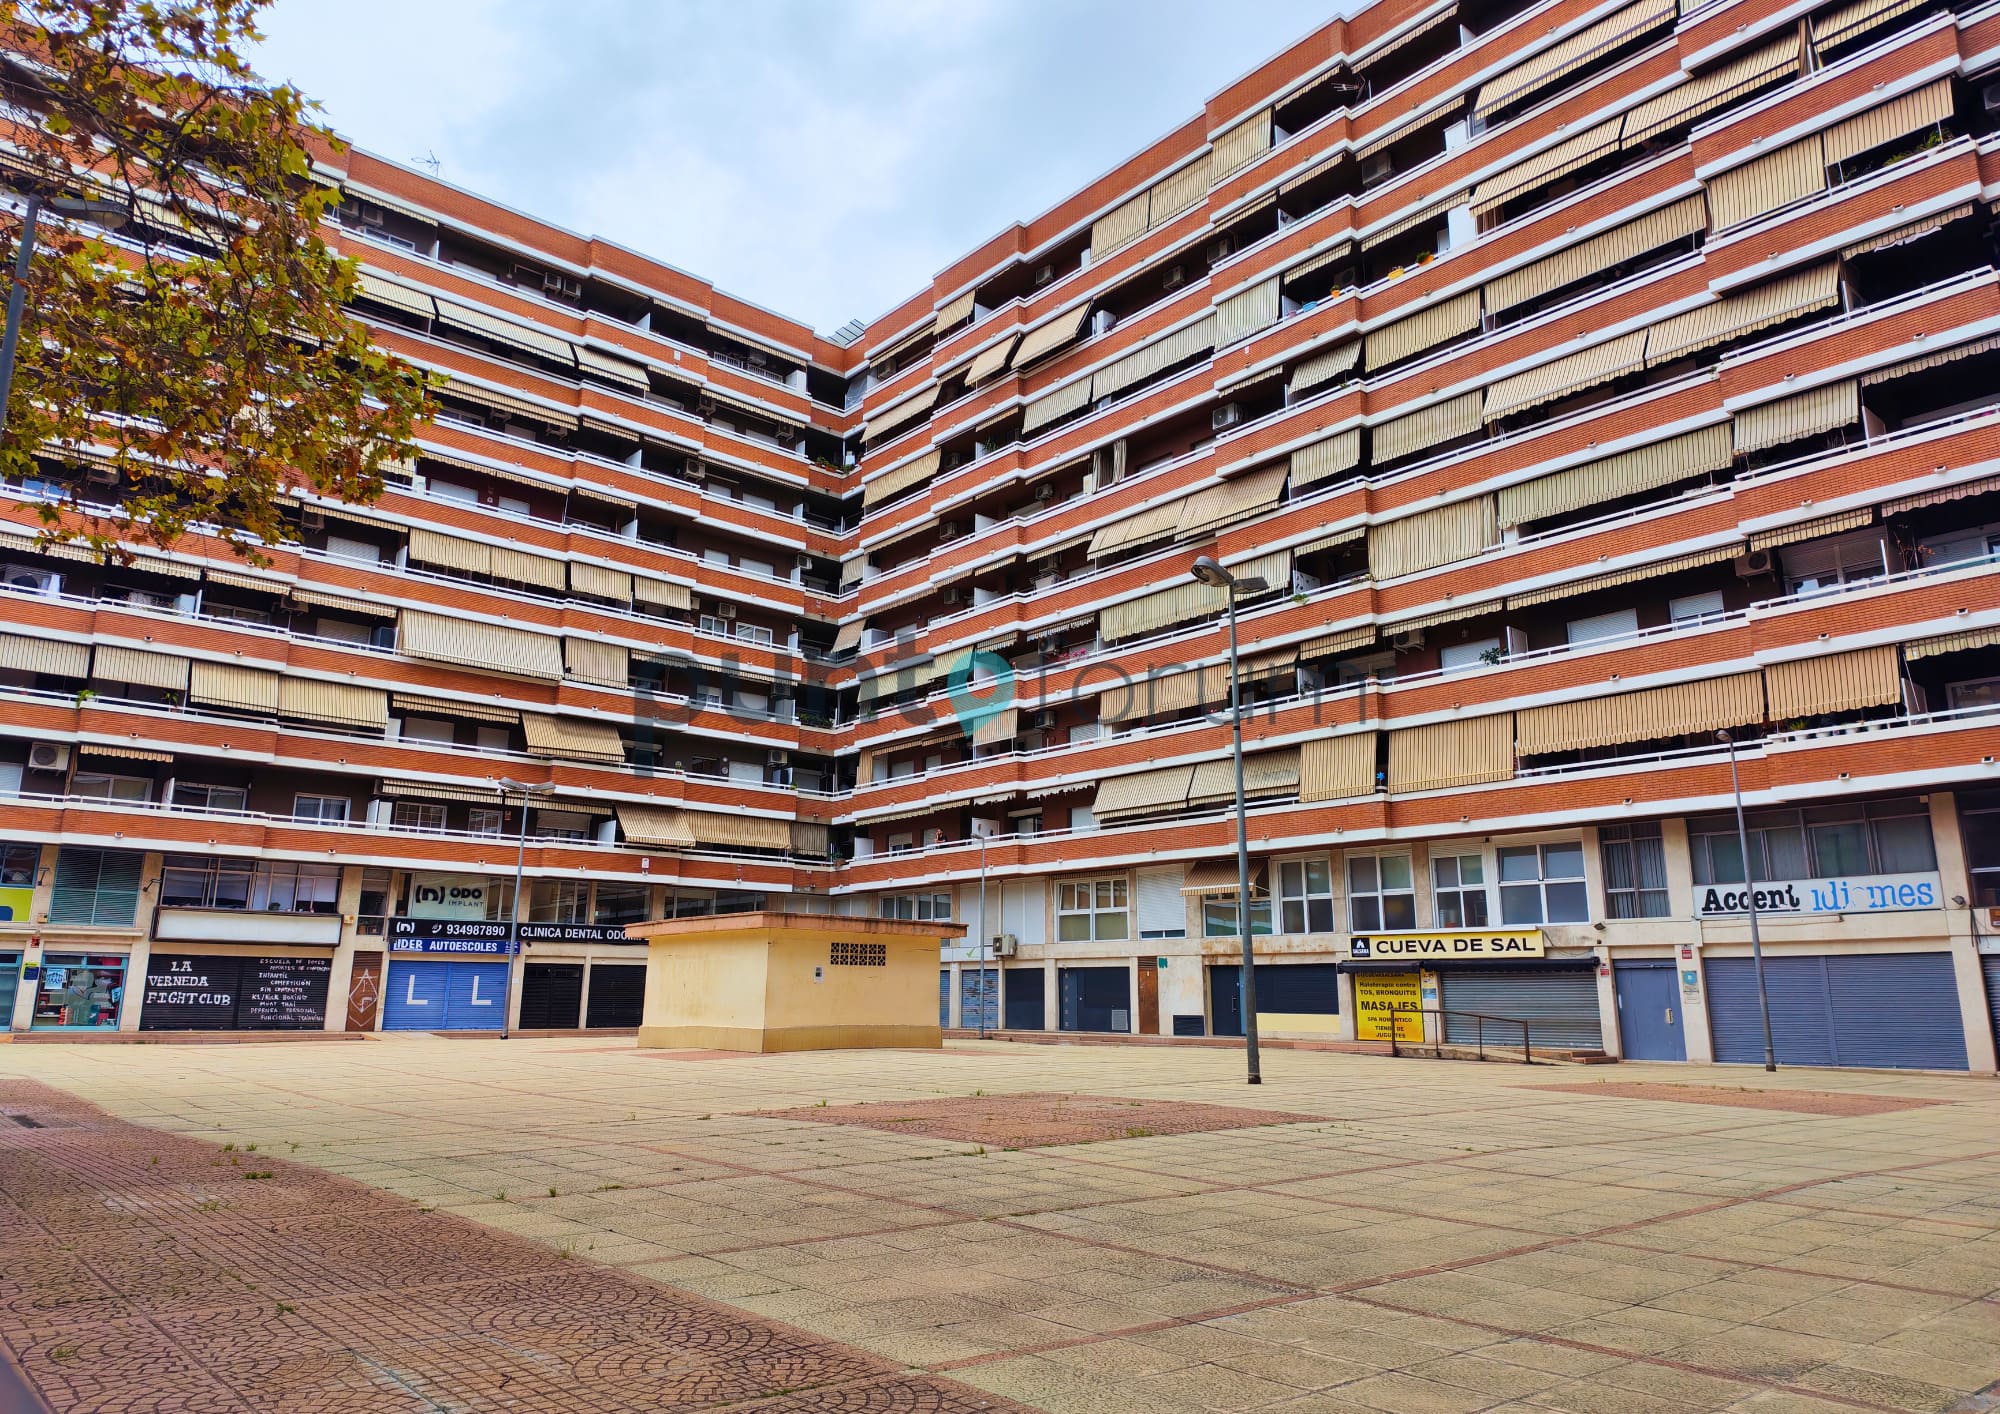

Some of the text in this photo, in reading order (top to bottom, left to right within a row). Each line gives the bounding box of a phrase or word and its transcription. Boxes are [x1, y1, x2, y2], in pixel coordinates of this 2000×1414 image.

[449, 887, 482, 899] ODO
[1701, 881, 1934, 912] Accent idimes
[446, 924, 505, 936] 934987890
[520, 926, 561, 938] CLINICA
[565, 928, 603, 940] DENTAL
[429, 941, 498, 952] AUTOESCOLES
[1376, 937, 1536, 953] CUEVA DE SAL
[170, 960, 192, 972] LA
[147, 975, 209, 987] VERNEDA
[407, 975, 492, 1005] L L
[146, 991, 231, 1006] FIGHT CLUB
